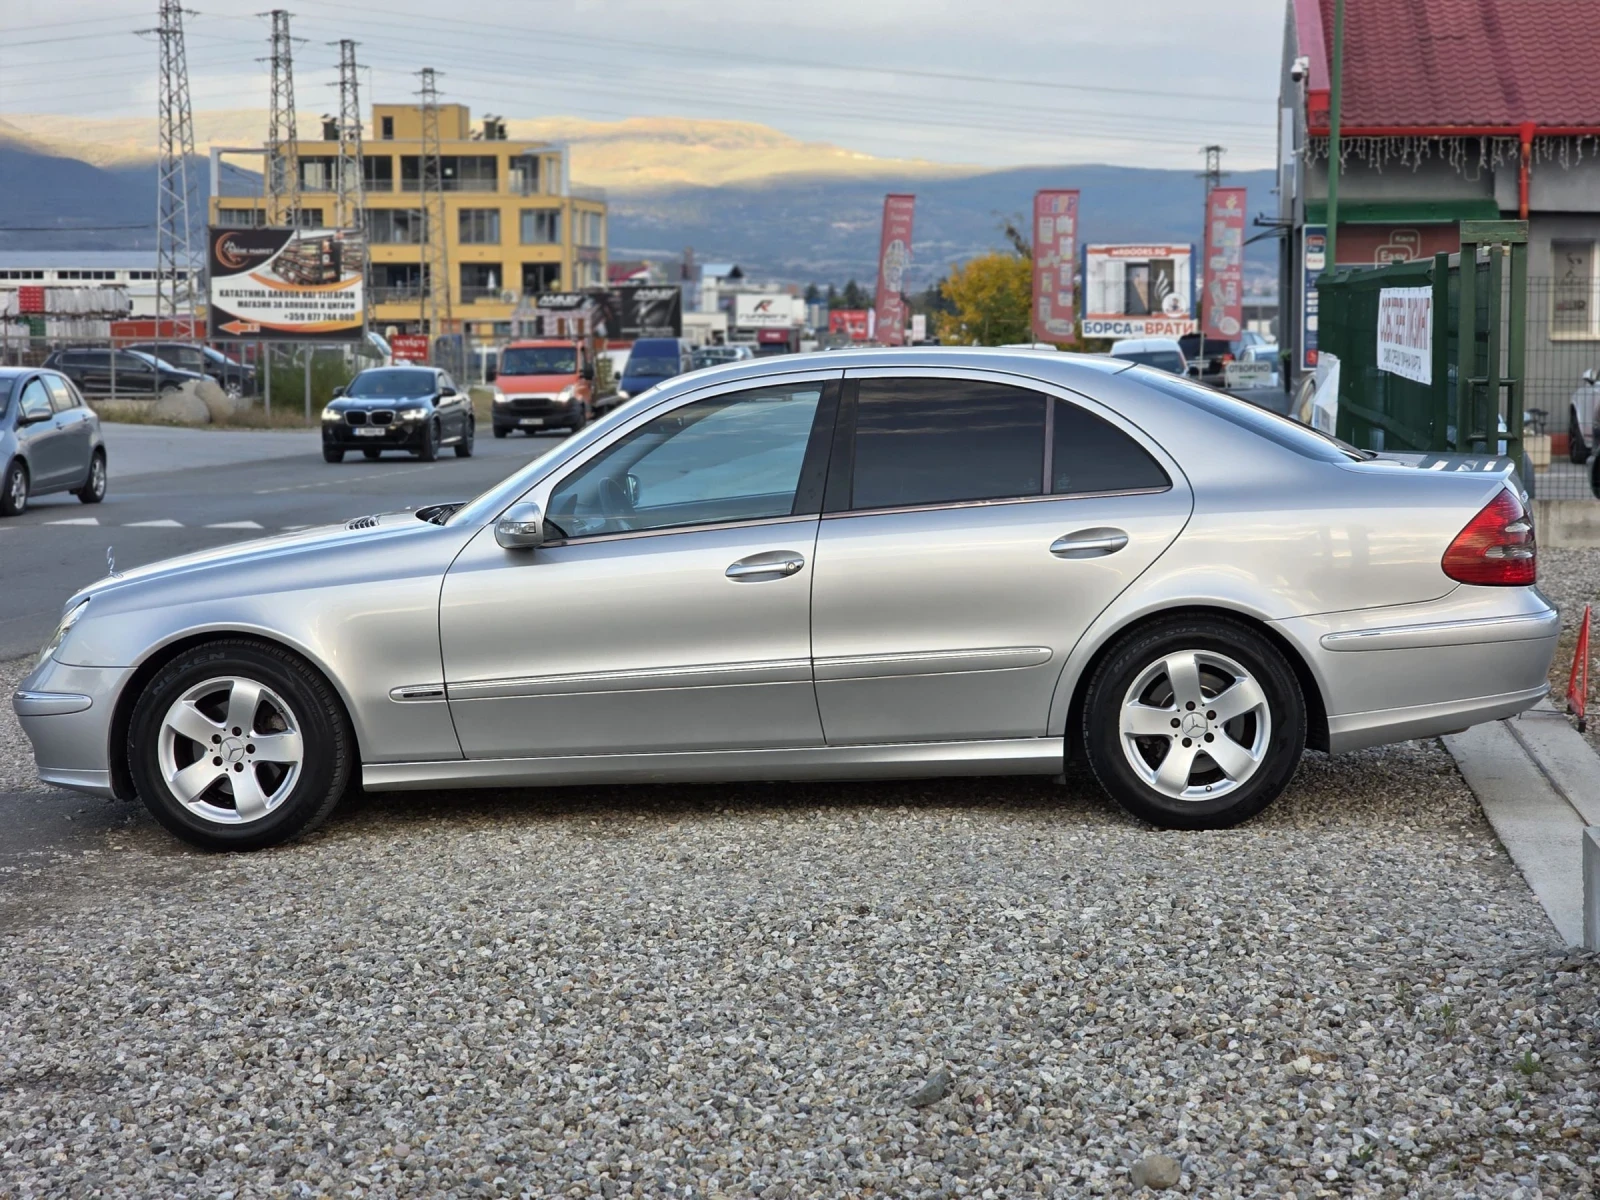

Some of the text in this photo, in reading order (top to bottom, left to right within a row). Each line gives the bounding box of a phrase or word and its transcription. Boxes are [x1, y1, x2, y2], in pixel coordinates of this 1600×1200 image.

[1380, 250, 1408, 262] Easy
[284, 313, 305, 321] +359
[1084, 322, 1133, 334] БОРСА
[1145, 322, 1194, 335] ВРАТИ
[1229, 364, 1269, 372] ОТВОРЕНО
[153, 652, 226, 695] NEXEN
